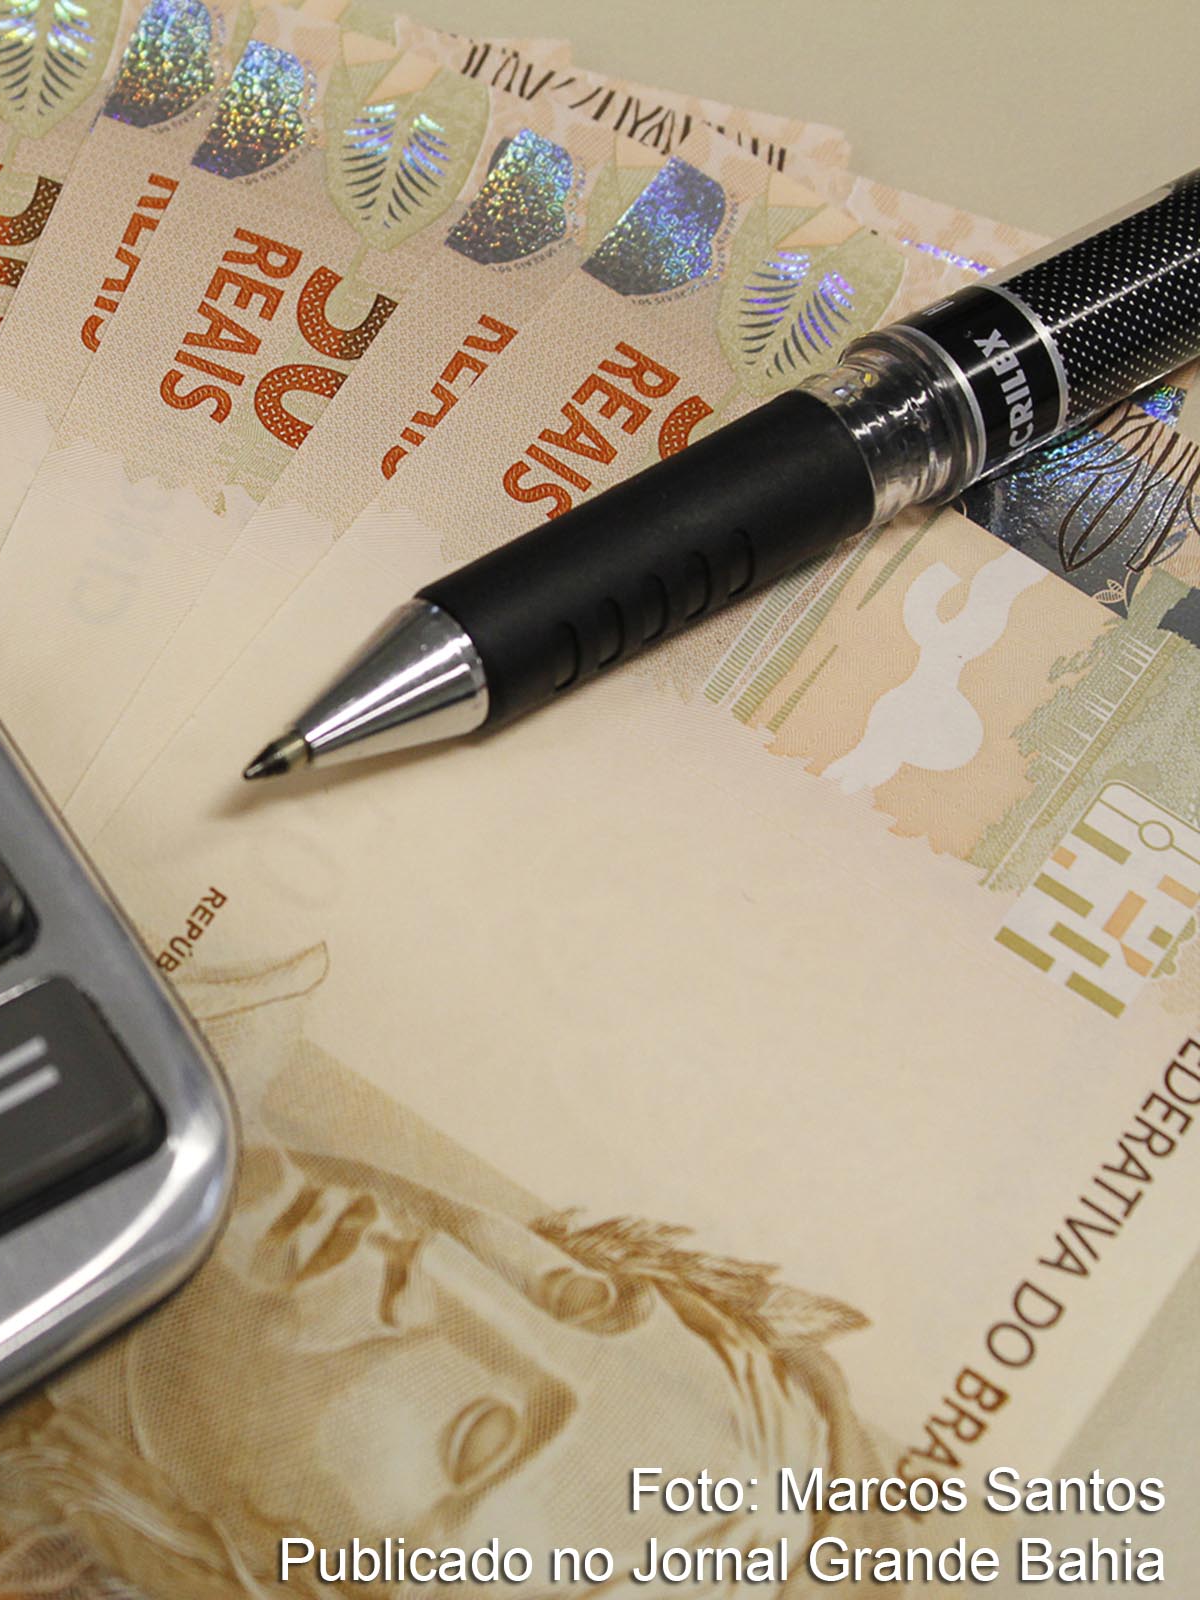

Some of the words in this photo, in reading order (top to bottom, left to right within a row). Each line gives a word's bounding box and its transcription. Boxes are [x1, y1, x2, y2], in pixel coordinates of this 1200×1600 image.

[159, 227, 303, 423] REAIS
[502, 341, 681, 519] REAIS
[986, 1280, 1065, 1370] DO
[870, 1366, 1010, 1524] BRAS
